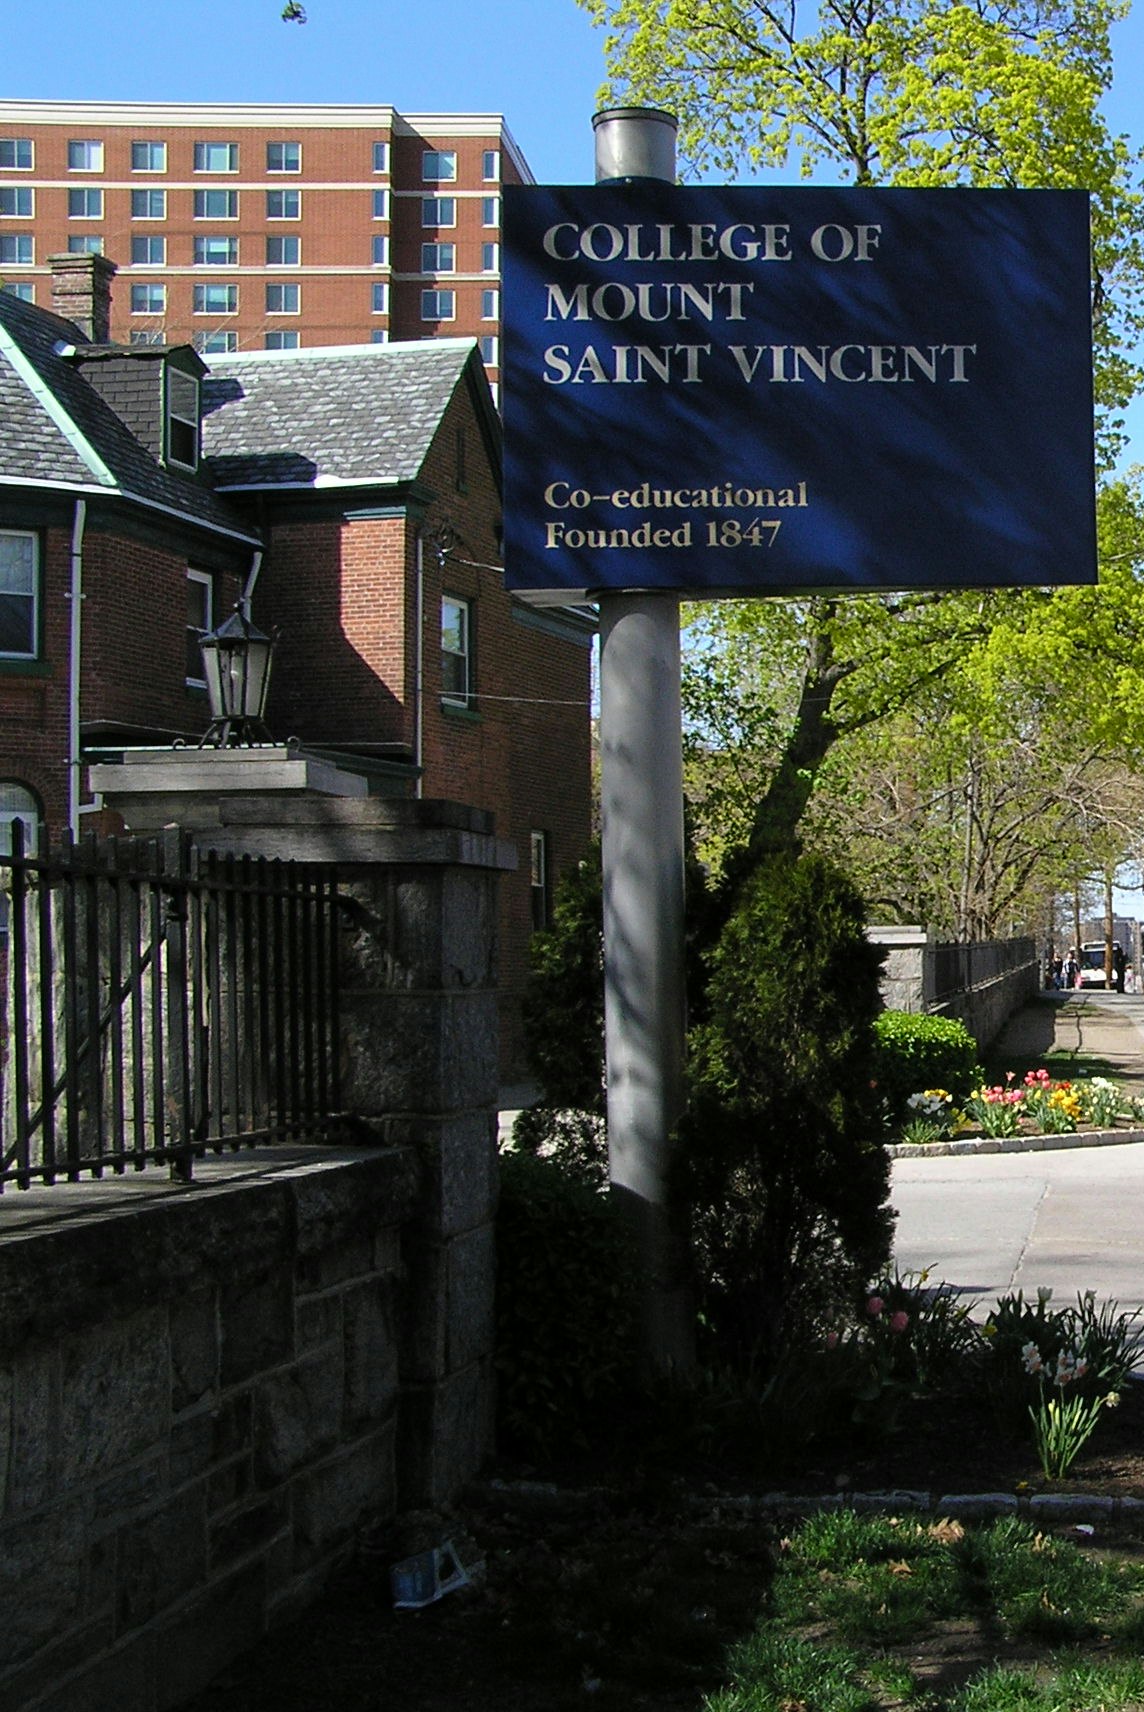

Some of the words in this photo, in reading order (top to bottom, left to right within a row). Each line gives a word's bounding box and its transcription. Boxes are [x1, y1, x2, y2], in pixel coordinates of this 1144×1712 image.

[543, 223, 792, 262] COLLEGE
[810, 223, 882, 262] OF
[543, 282, 754, 322] MOUNT
[542, 343, 711, 384] SAINT
[727, 343, 977, 383] VINCENT
[544, 481, 808, 509] Co-educational
[545, 521, 692, 549] Founded
[707, 517, 783, 547] 1847
